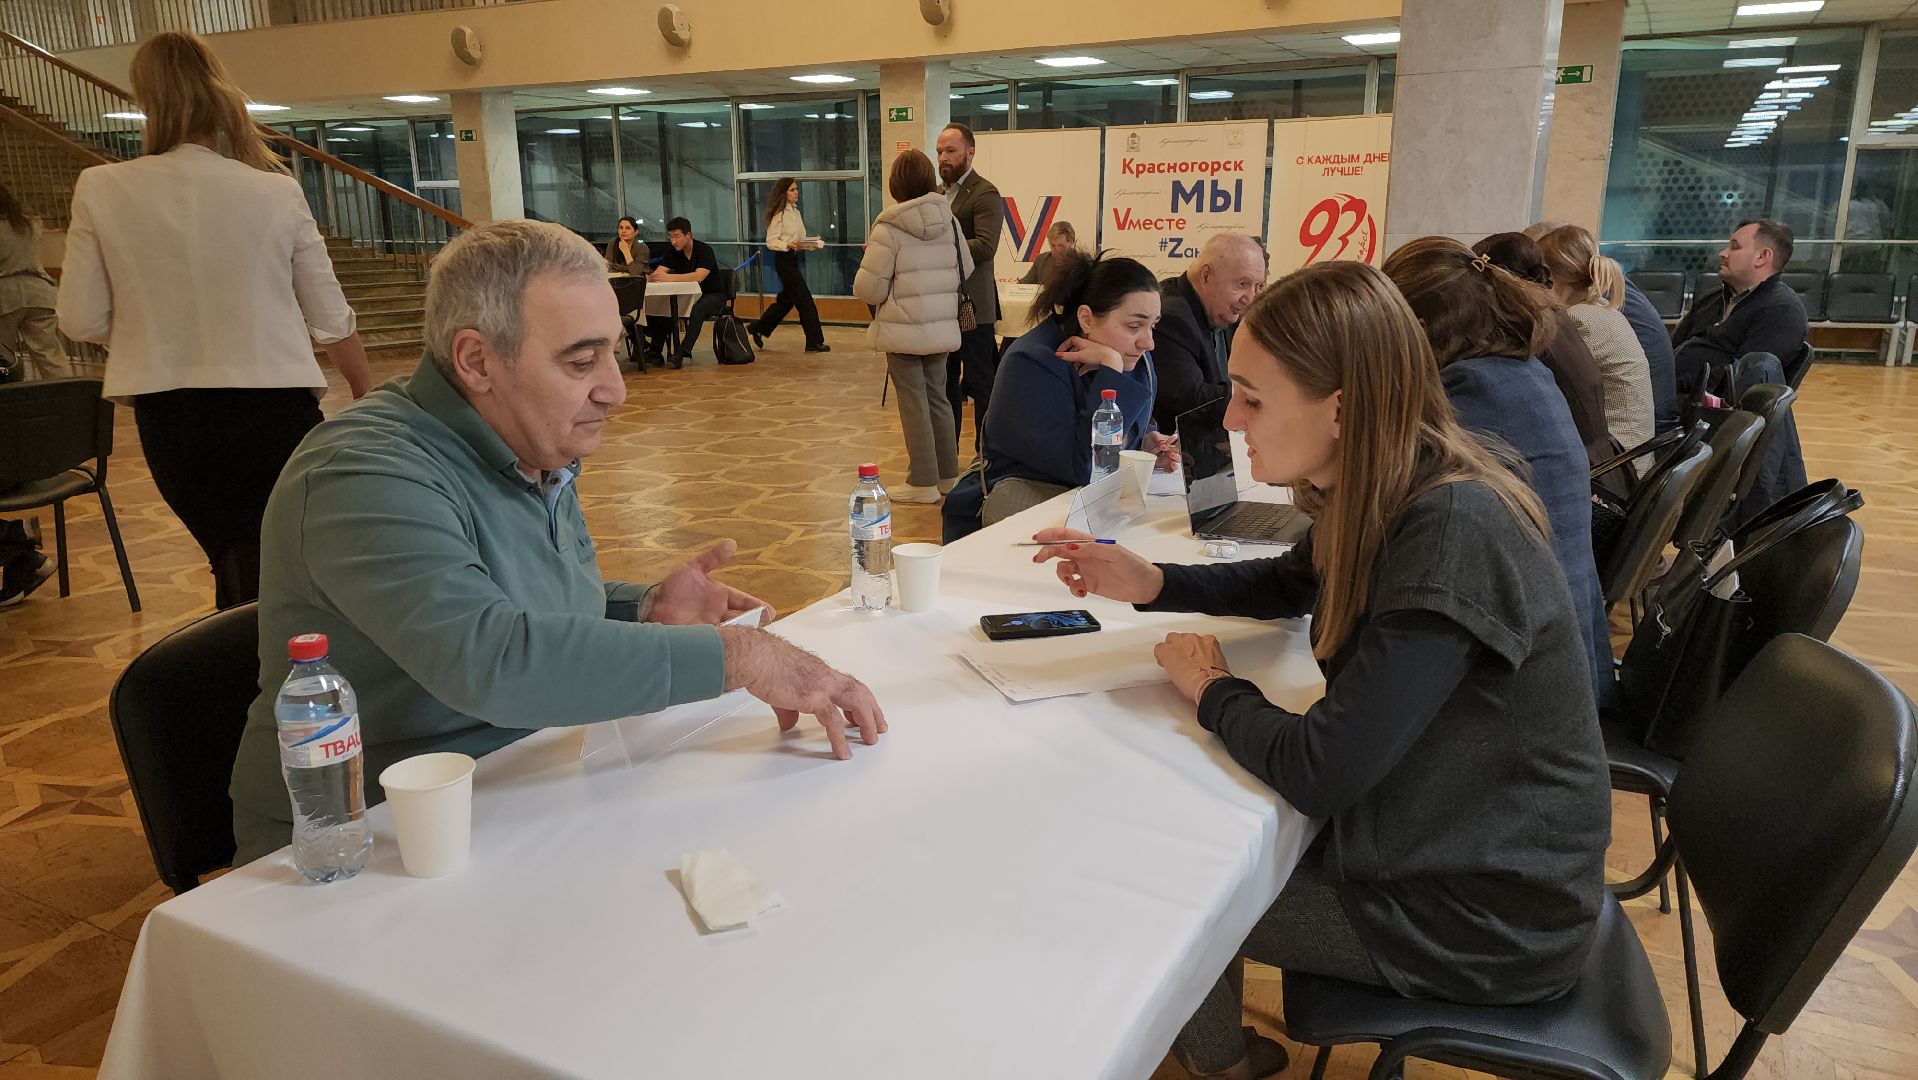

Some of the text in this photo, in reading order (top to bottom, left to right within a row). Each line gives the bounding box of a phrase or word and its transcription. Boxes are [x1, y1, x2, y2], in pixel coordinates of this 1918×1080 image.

[1122, 157, 1244, 178] Красногорск
[1296, 152, 1391, 165] С КАЖДЫМ ДНЕ
[1322, 166, 1364, 177] ЛУЧШЕ!
[1171, 178, 1243, 213] МЫ
[1113, 207, 1186, 231] Vместе
